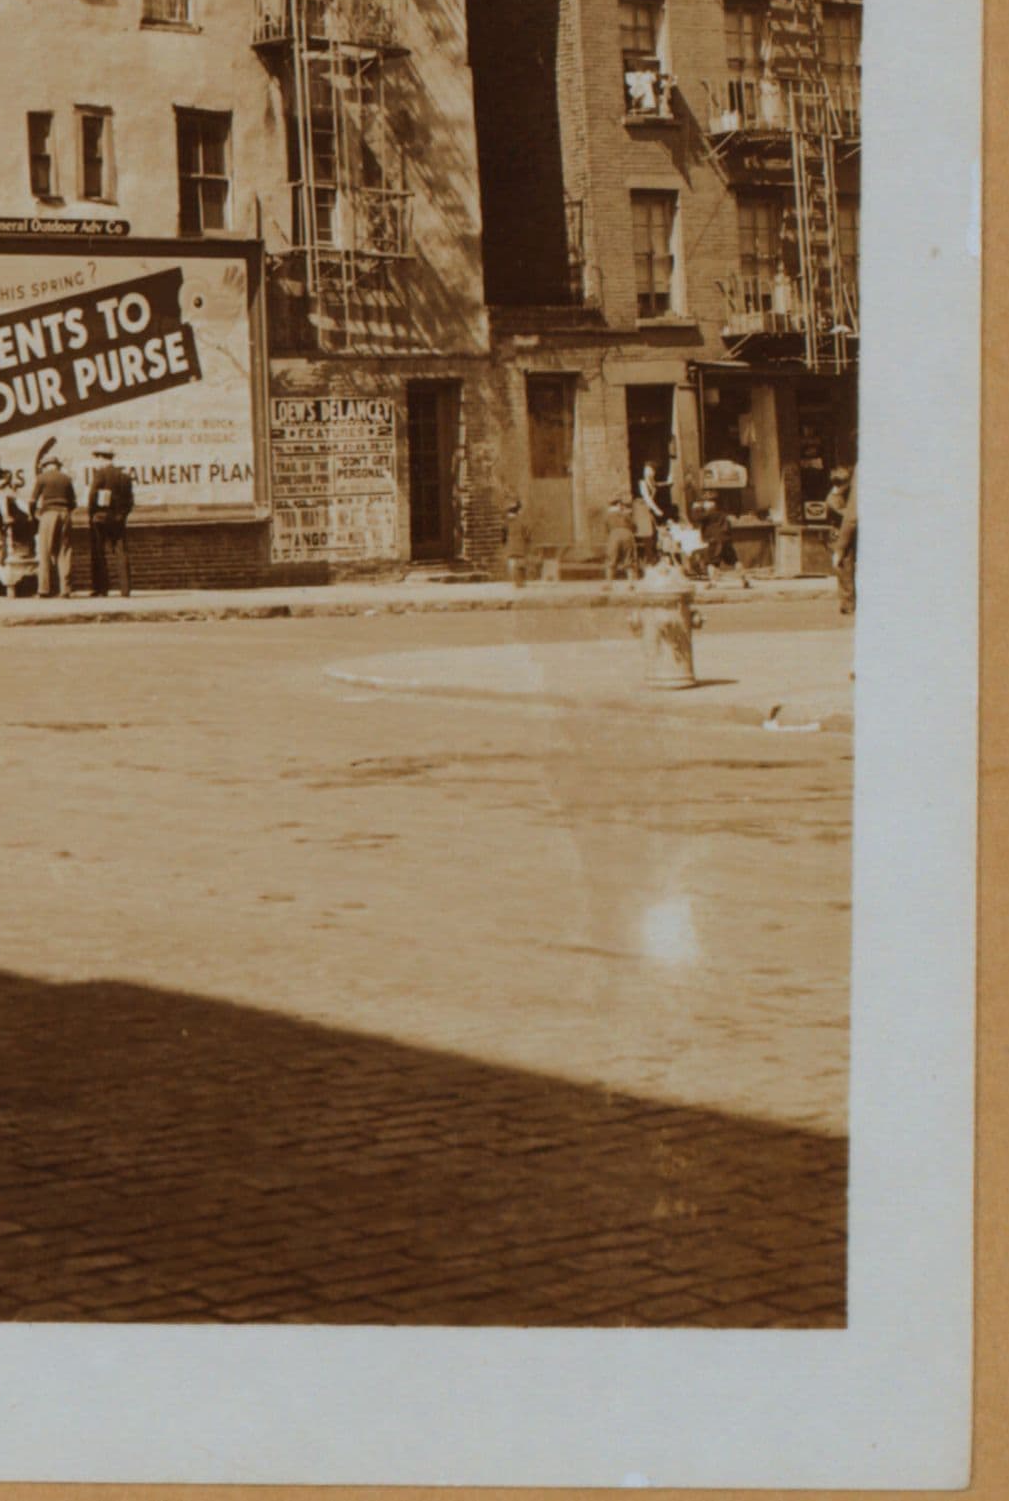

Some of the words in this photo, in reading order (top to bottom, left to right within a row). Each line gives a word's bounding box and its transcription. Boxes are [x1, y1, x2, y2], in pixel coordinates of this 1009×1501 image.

[30, 218, 77, 233] Outdoor
[96, 291, 151, 340] TO
[73, 331, 190, 401] PURSE
[320, 399, 391, 422] DELANCEY
[209, 461, 254, 483] PLAN
